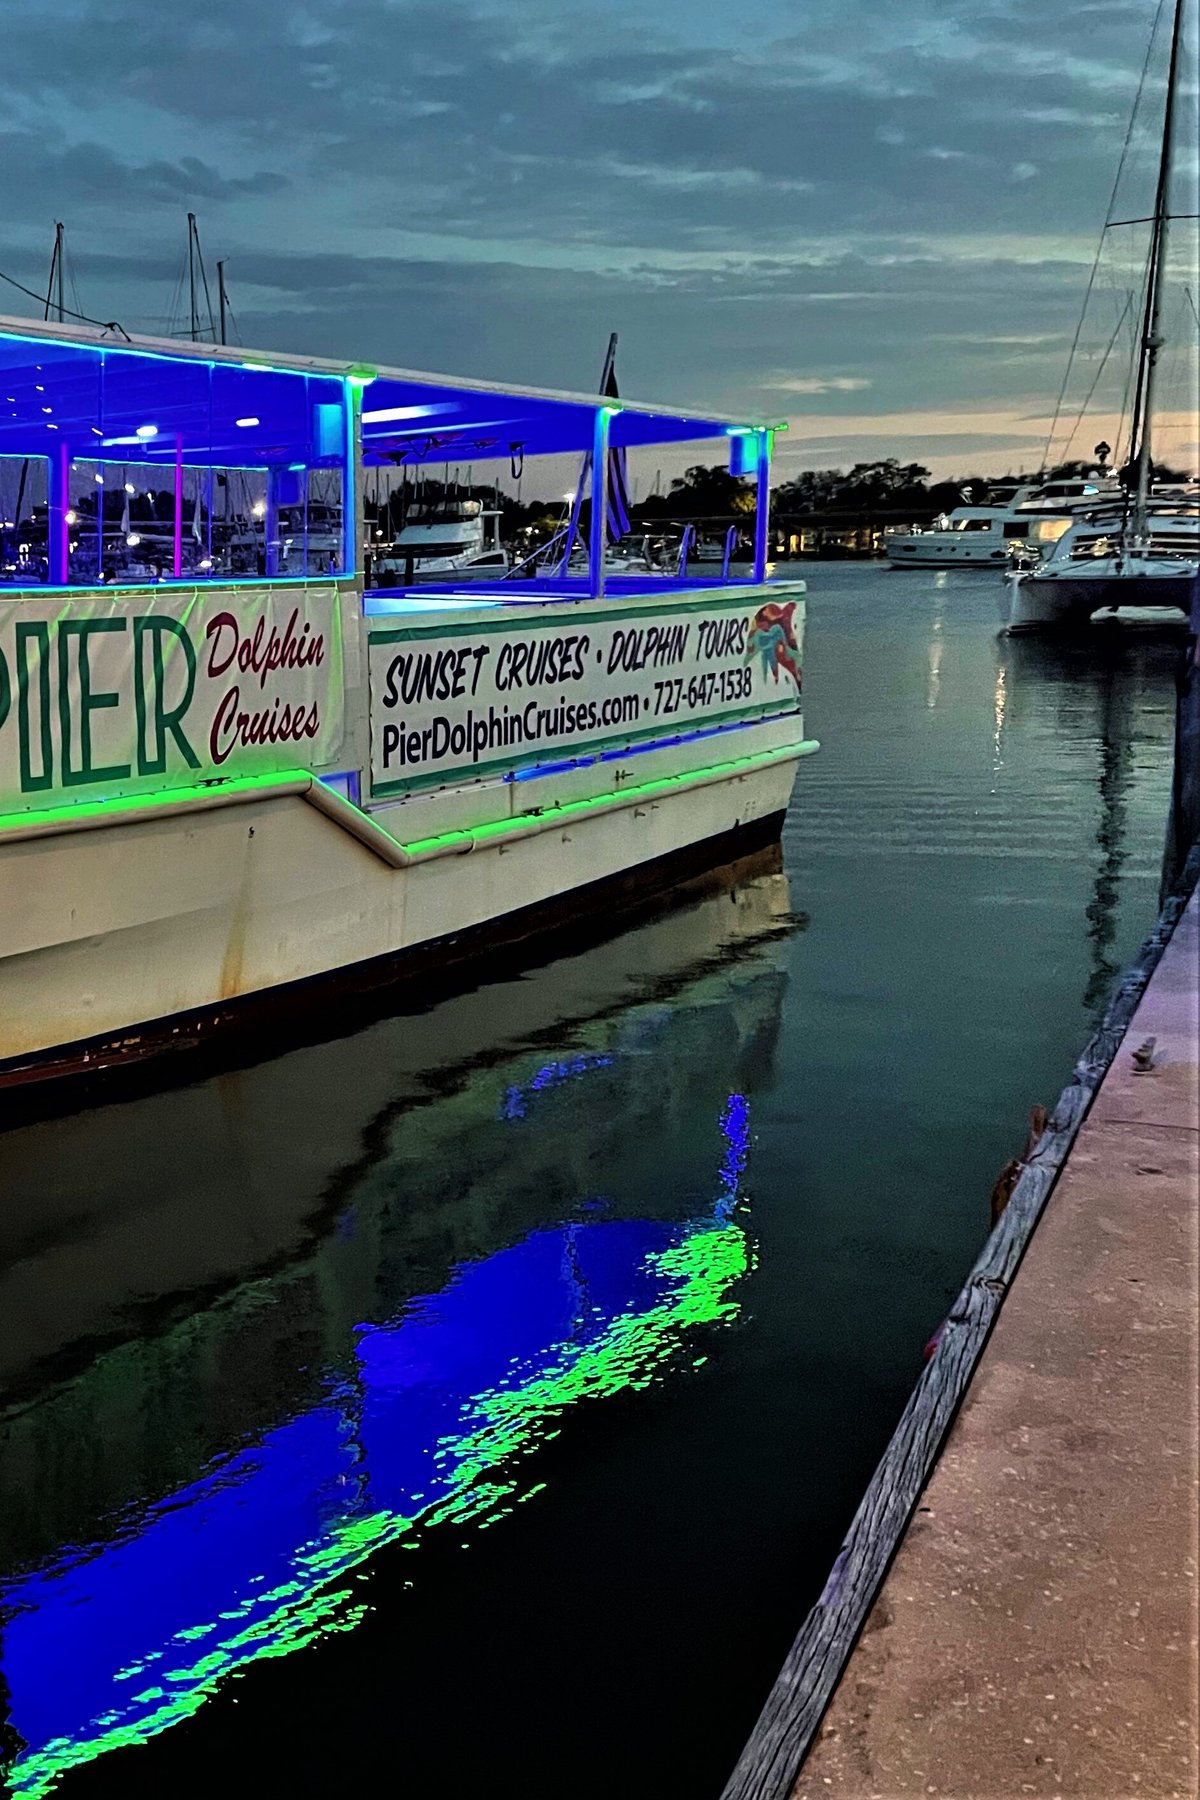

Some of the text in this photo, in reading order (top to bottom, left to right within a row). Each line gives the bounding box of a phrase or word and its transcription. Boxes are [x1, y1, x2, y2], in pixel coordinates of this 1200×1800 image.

[206, 607, 324, 690] Dolphin
[382, 617, 749, 708] SUNSET CRUISES DOLPHIN TOURS
[209, 685, 319, 765] Cruises
[382, 667, 752, 769] PierDolphinCruises.com 727-647-1538
